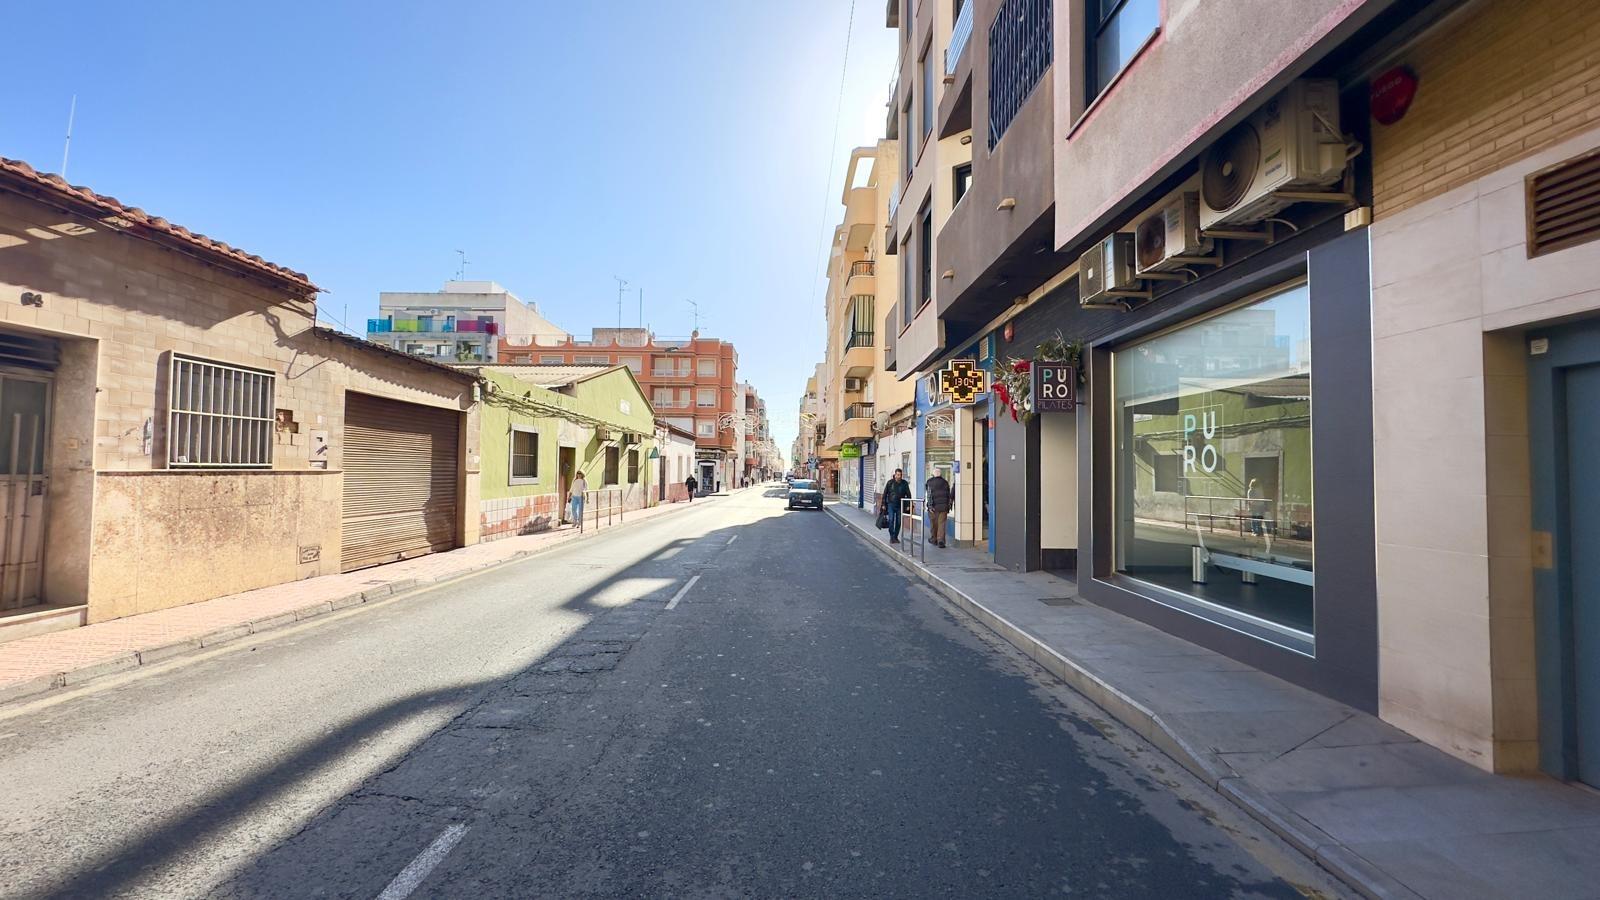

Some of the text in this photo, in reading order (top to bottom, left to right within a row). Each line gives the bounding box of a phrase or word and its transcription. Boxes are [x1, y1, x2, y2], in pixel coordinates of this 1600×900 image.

[1043, 384, 1068, 398] RO
[1038, 400, 1073, 410] PILATES
[1183, 444, 1218, 473] RO
